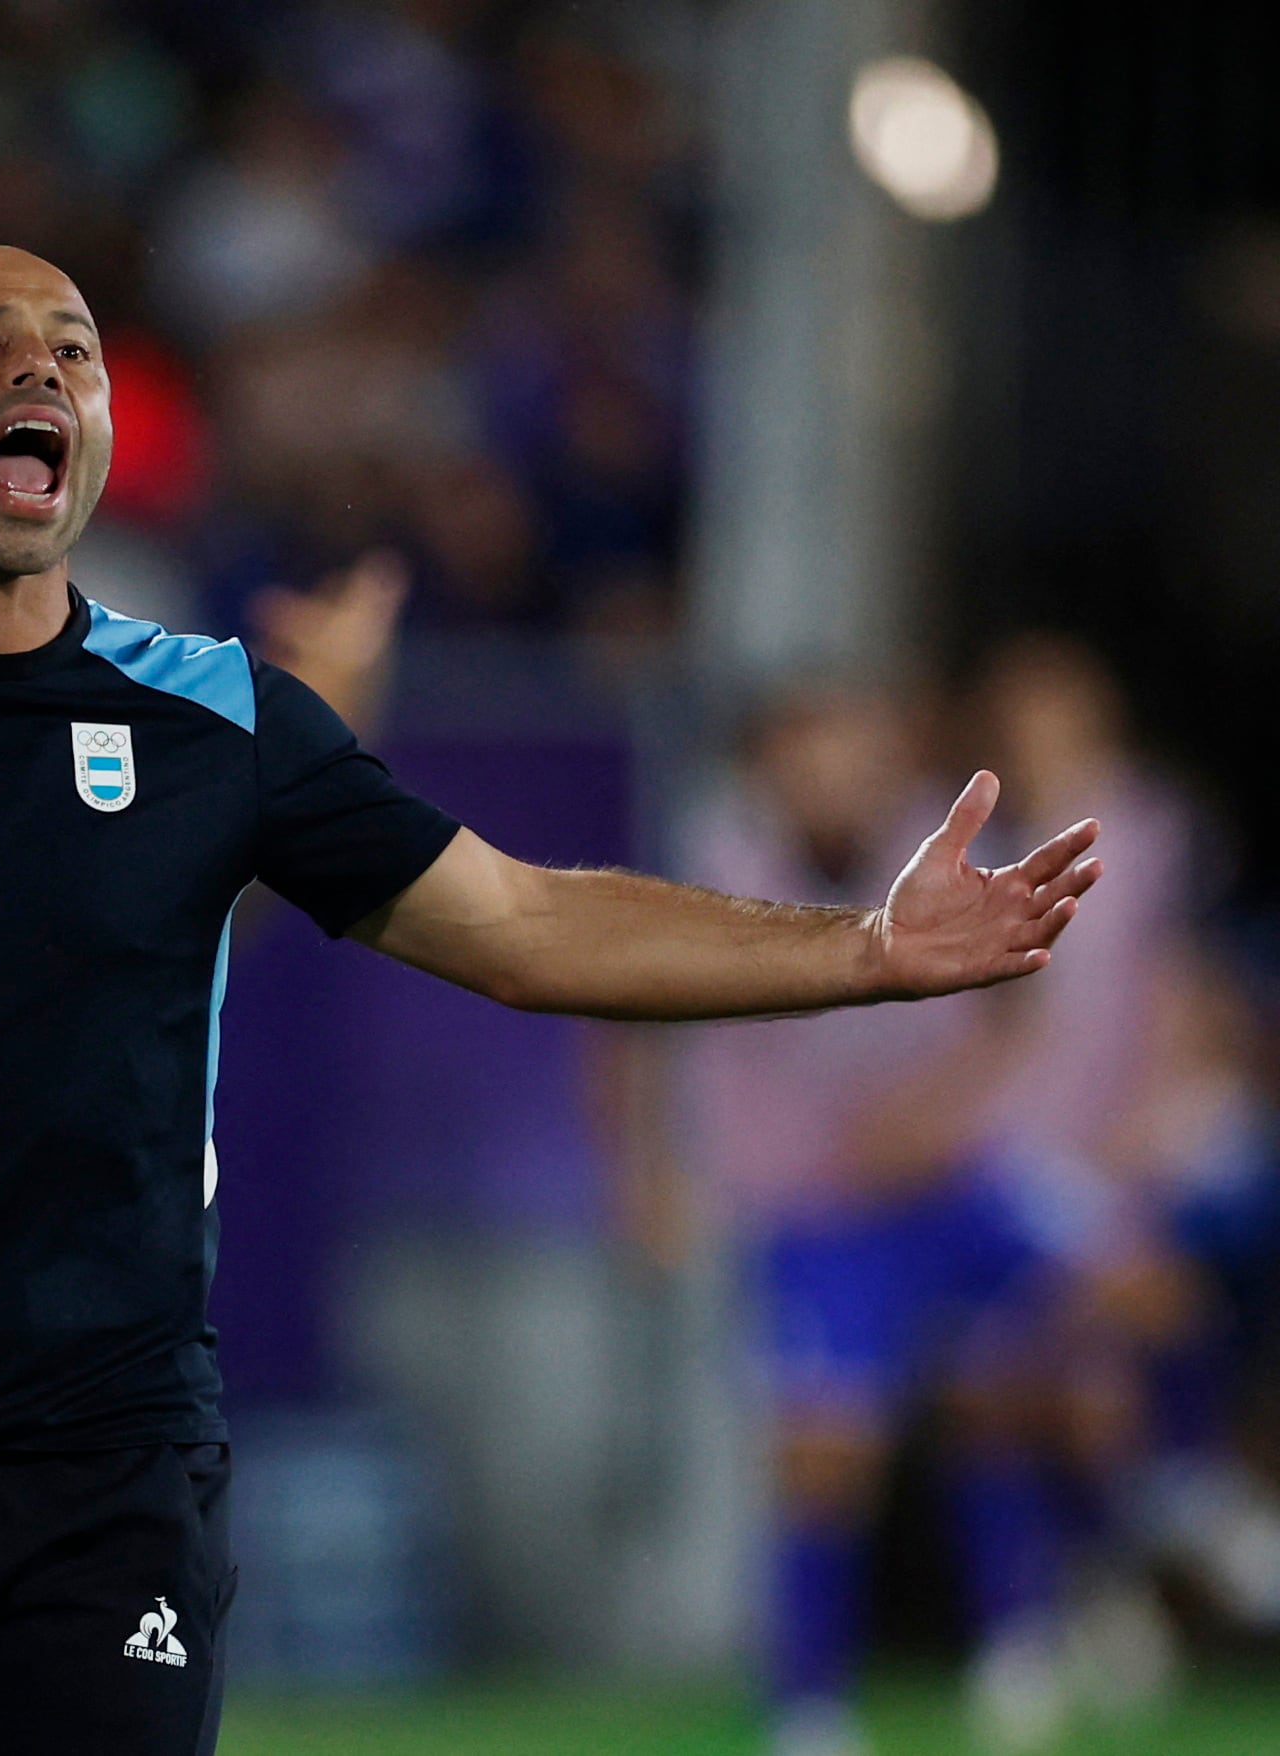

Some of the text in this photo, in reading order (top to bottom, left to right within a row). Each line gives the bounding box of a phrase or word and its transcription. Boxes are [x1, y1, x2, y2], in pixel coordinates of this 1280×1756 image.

[83, 788, 122, 808] OLIMPICO
[122, 756, 132, 802] ARGENTINO
[123, 1644, 187, 1668] LE COQ SPORTIF
